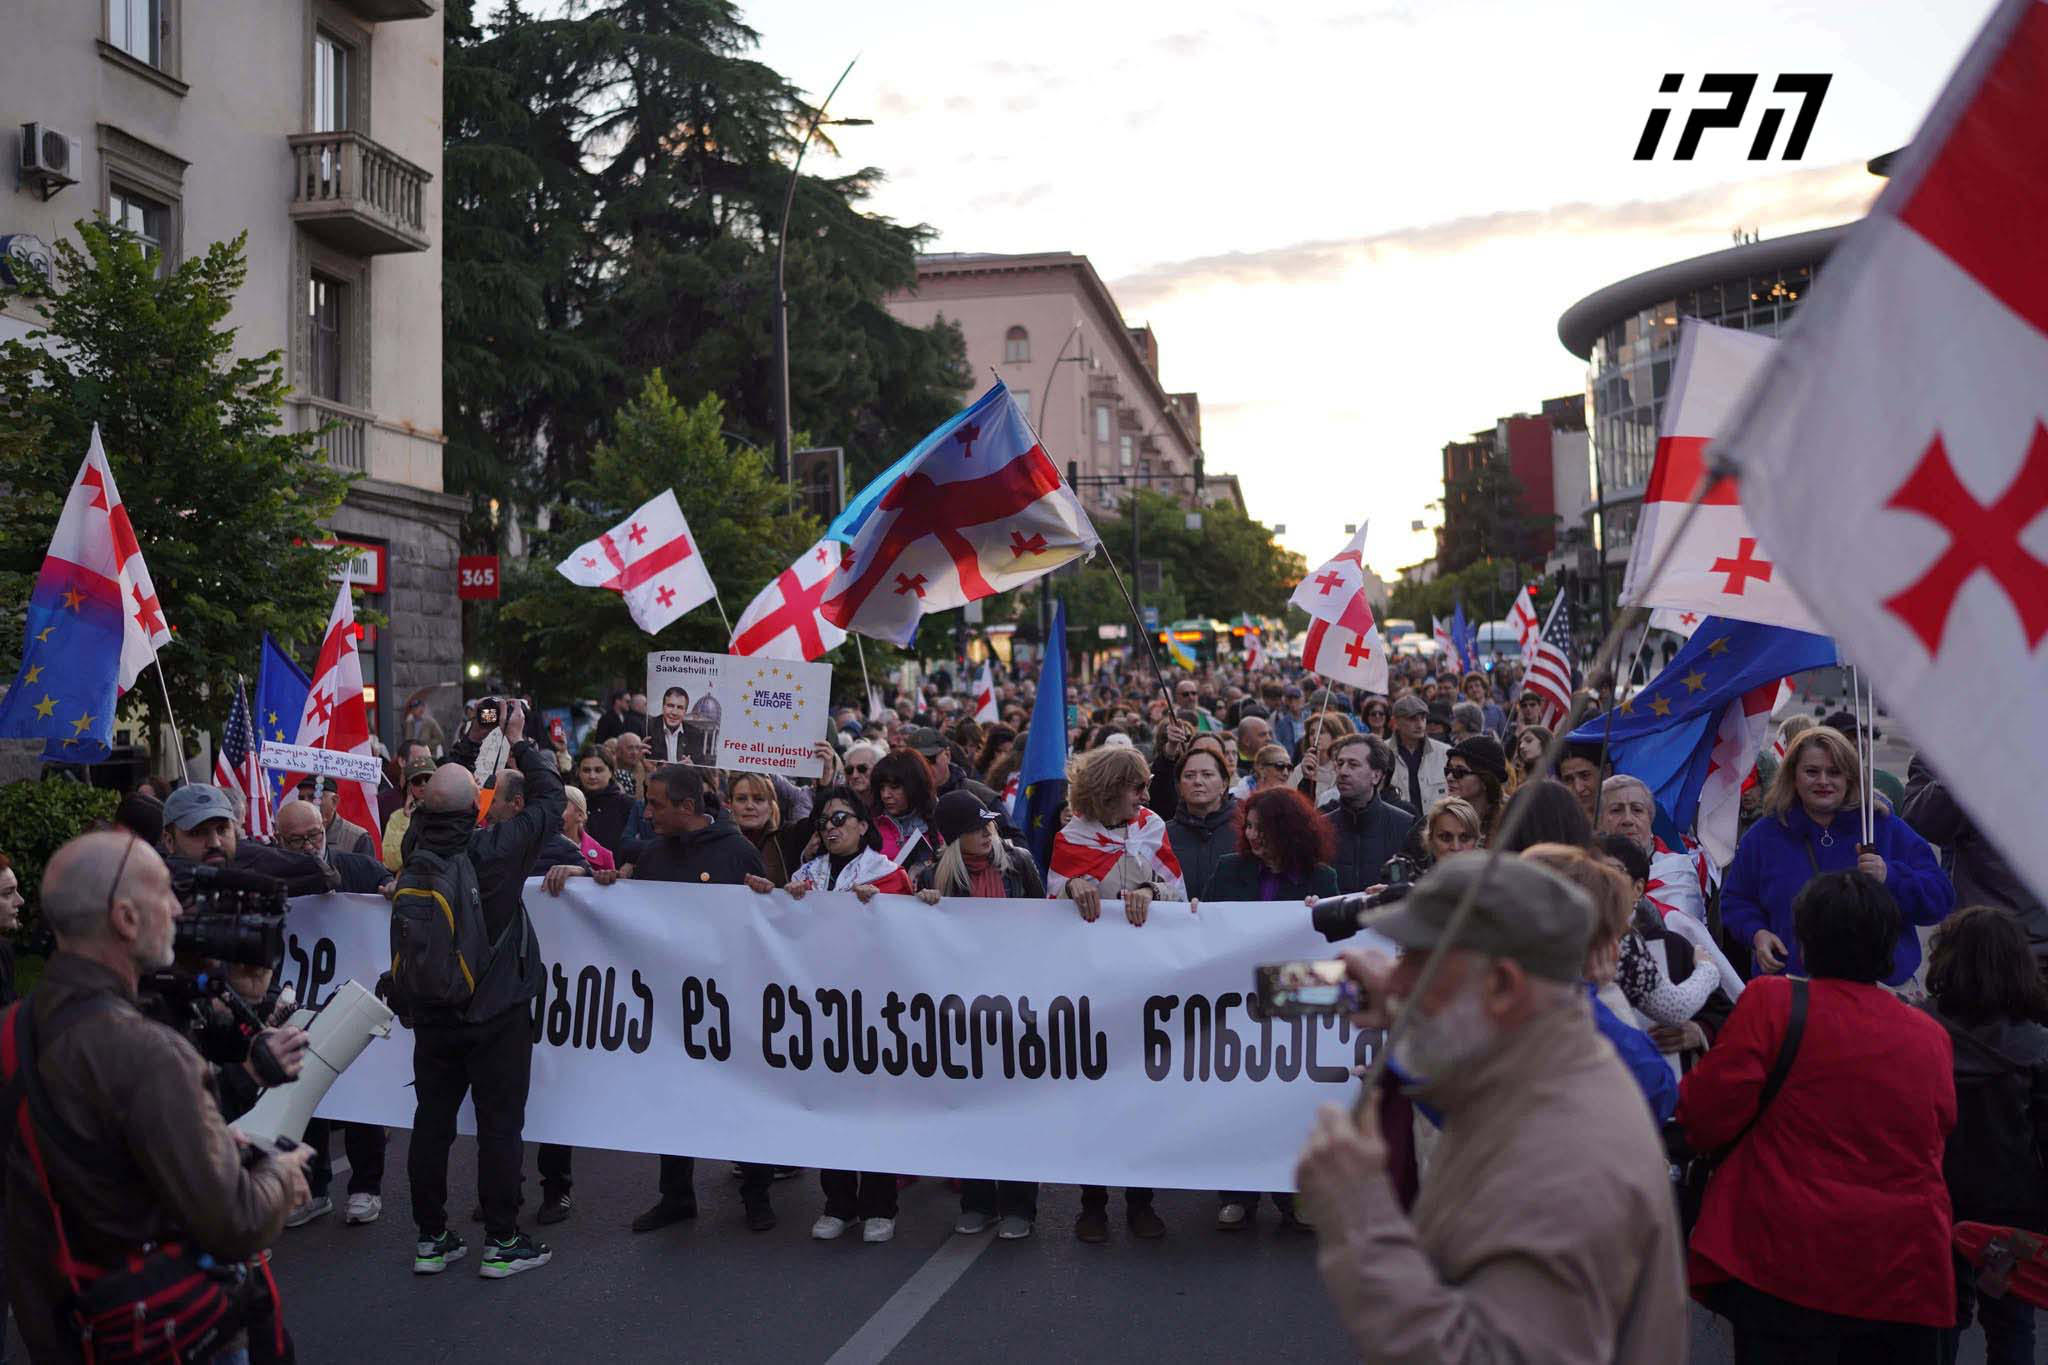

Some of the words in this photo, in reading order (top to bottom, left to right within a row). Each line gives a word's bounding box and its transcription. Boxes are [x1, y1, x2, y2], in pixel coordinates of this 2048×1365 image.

[462, 569, 495, 586] 365
[660, 655, 681, 663] Free
[683, 655, 715, 665] Mikheil
[656, 665, 707, 675] Saakashvili
[709, 667, 718, 676] !!!
[755, 690, 770, 699] WE
[772, 692, 792, 700] ARE
[753, 698, 793, 709] EUROPE
[724, 740, 747, 750] Free
[750, 742, 764, 752] all
[768, 744, 813, 759] unjustly
[738, 755, 796, 768] arrested!!!
[682, 976, 731, 1062] და
[762, 983, 1107, 1080] დაუსჯელობის
